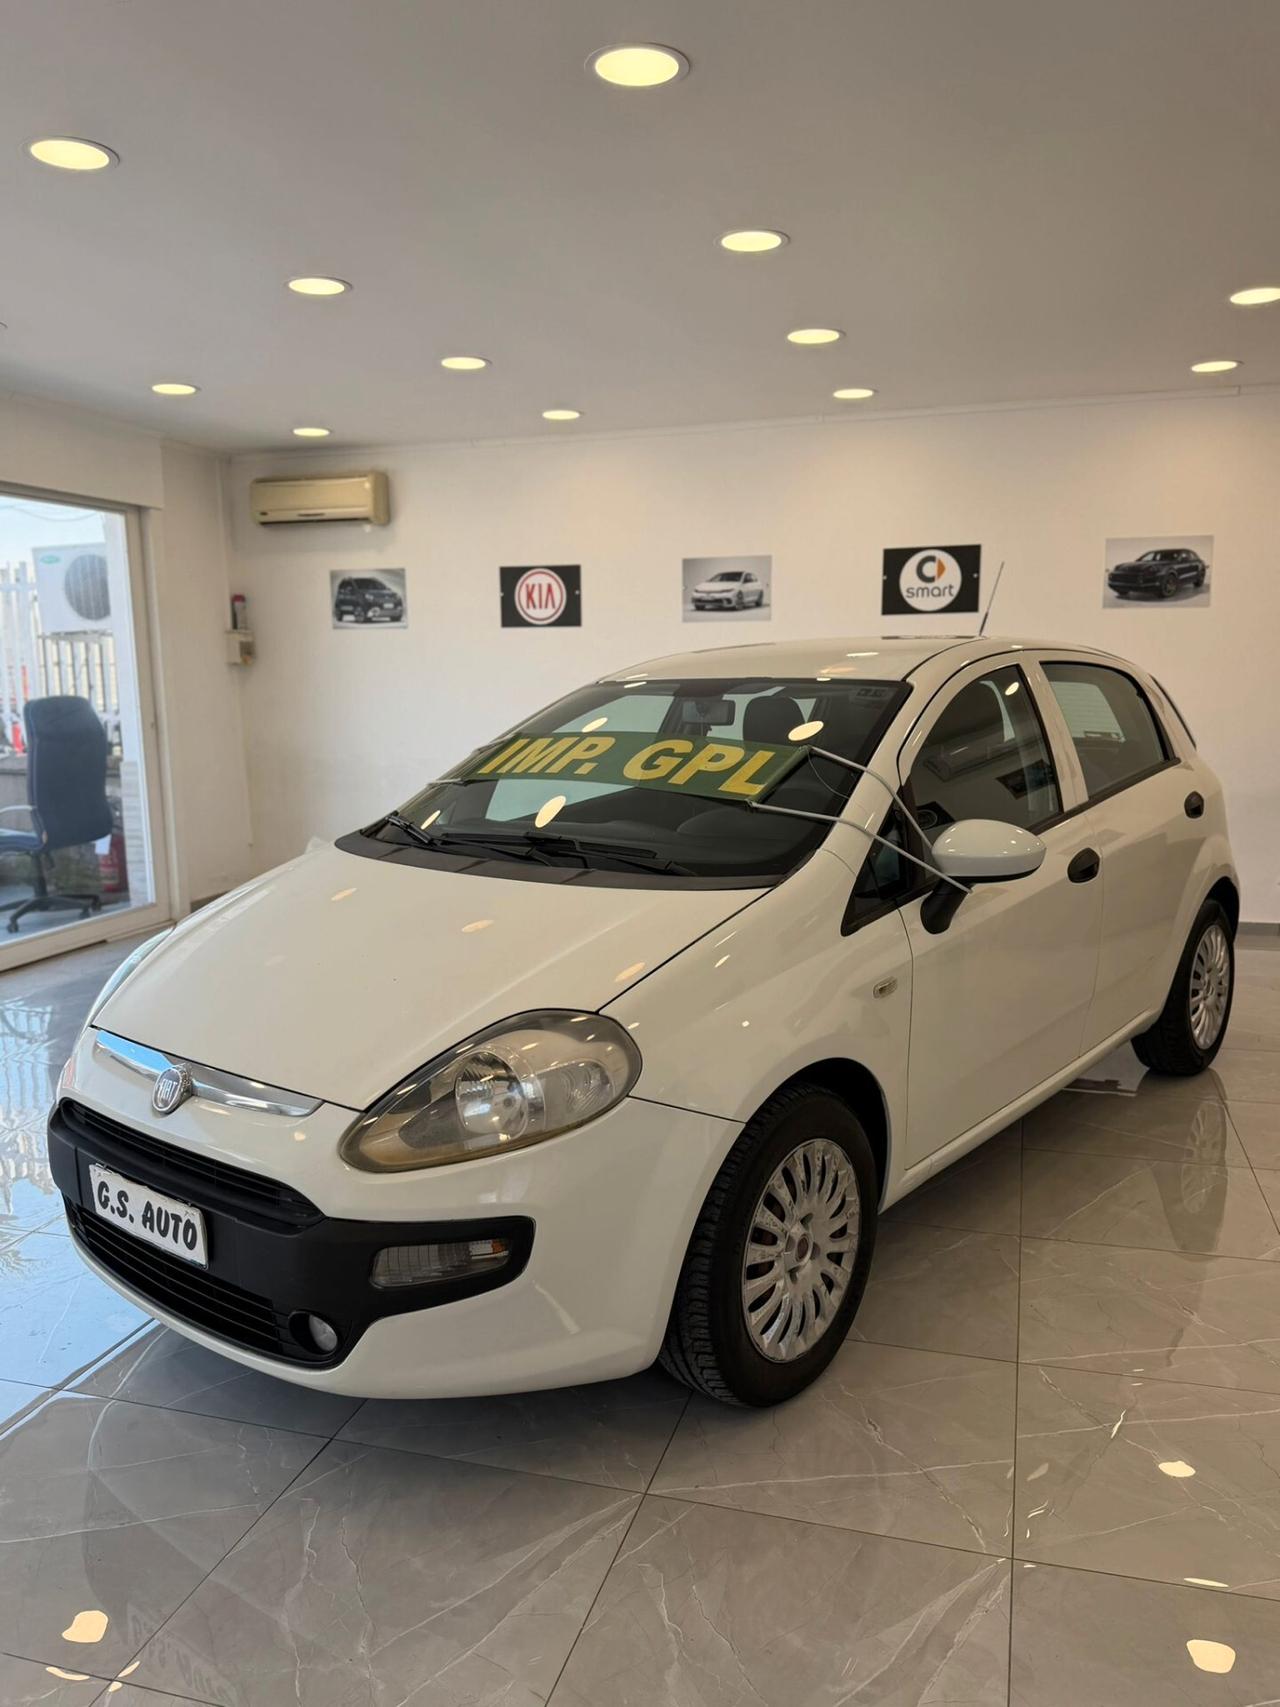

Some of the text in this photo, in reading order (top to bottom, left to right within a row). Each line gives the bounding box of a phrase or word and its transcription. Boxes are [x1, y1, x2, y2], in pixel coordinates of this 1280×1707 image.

[525, 583, 556, 610] KIA
[905, 584, 954, 598] smart
[477, 736, 776, 796] IMP. GPL
[156, 1077, 179, 1103] FIAT
[97, 1181, 198, 1251] G.S. AUTO
